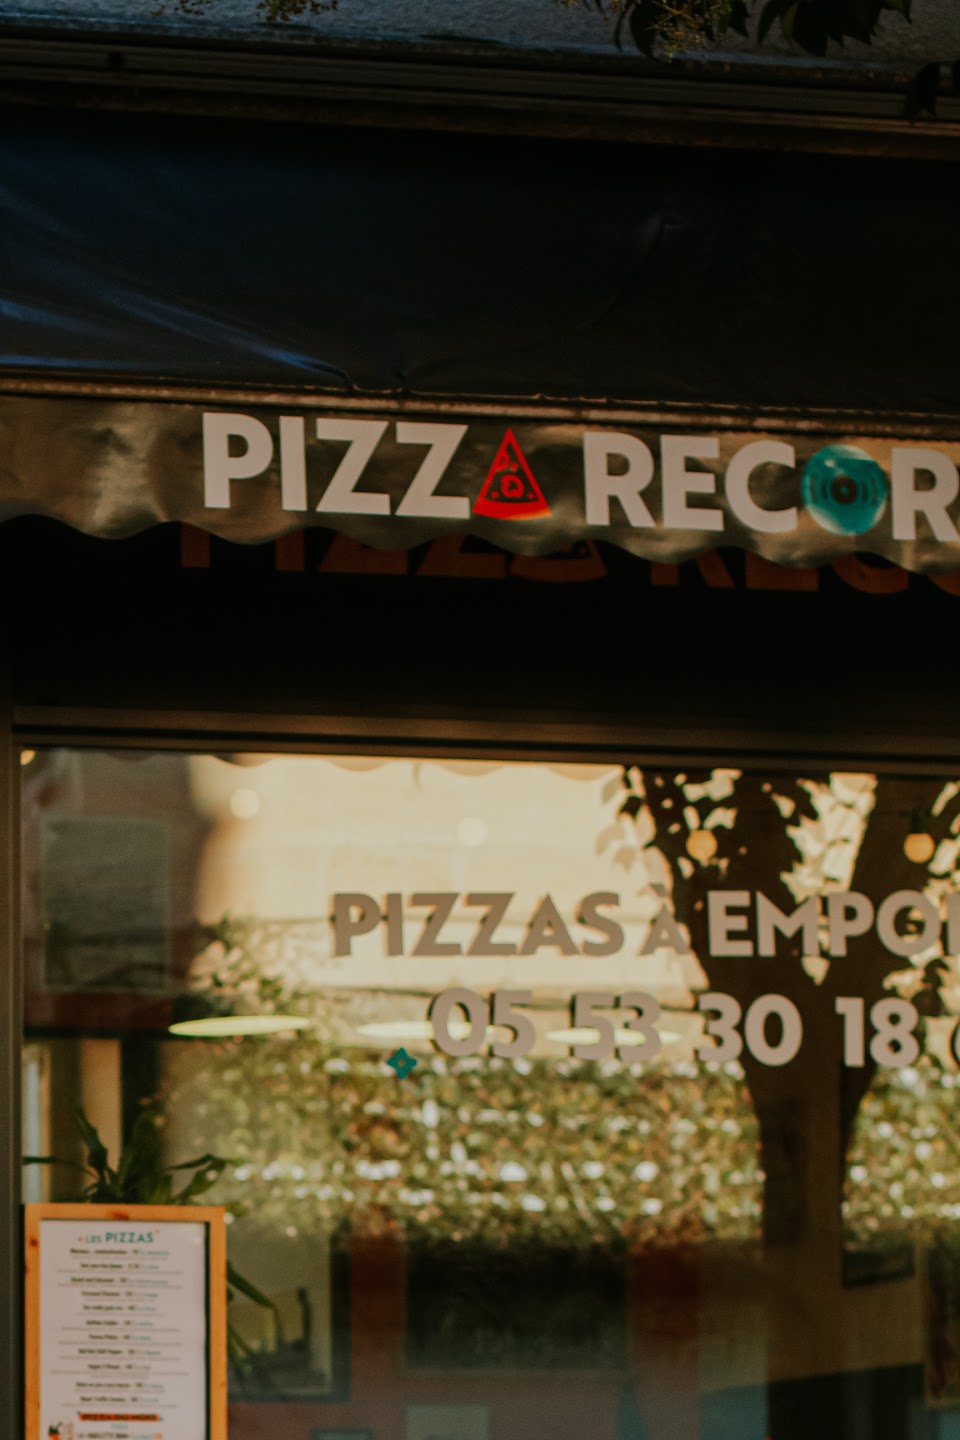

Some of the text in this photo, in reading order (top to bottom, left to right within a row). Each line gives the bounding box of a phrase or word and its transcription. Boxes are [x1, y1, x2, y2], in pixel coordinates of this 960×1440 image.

[332, 890, 626, 957] PIZZAS
[707, 888, 960, 957] EMPO
[429, 986, 537, 1058] 05
[572, 990, 663, 1063] 53
[697, 991, 804, 1067] 30
[834, 996, 921, 1068] 18
[105, 1231, 154, 1244] PIZZAS
